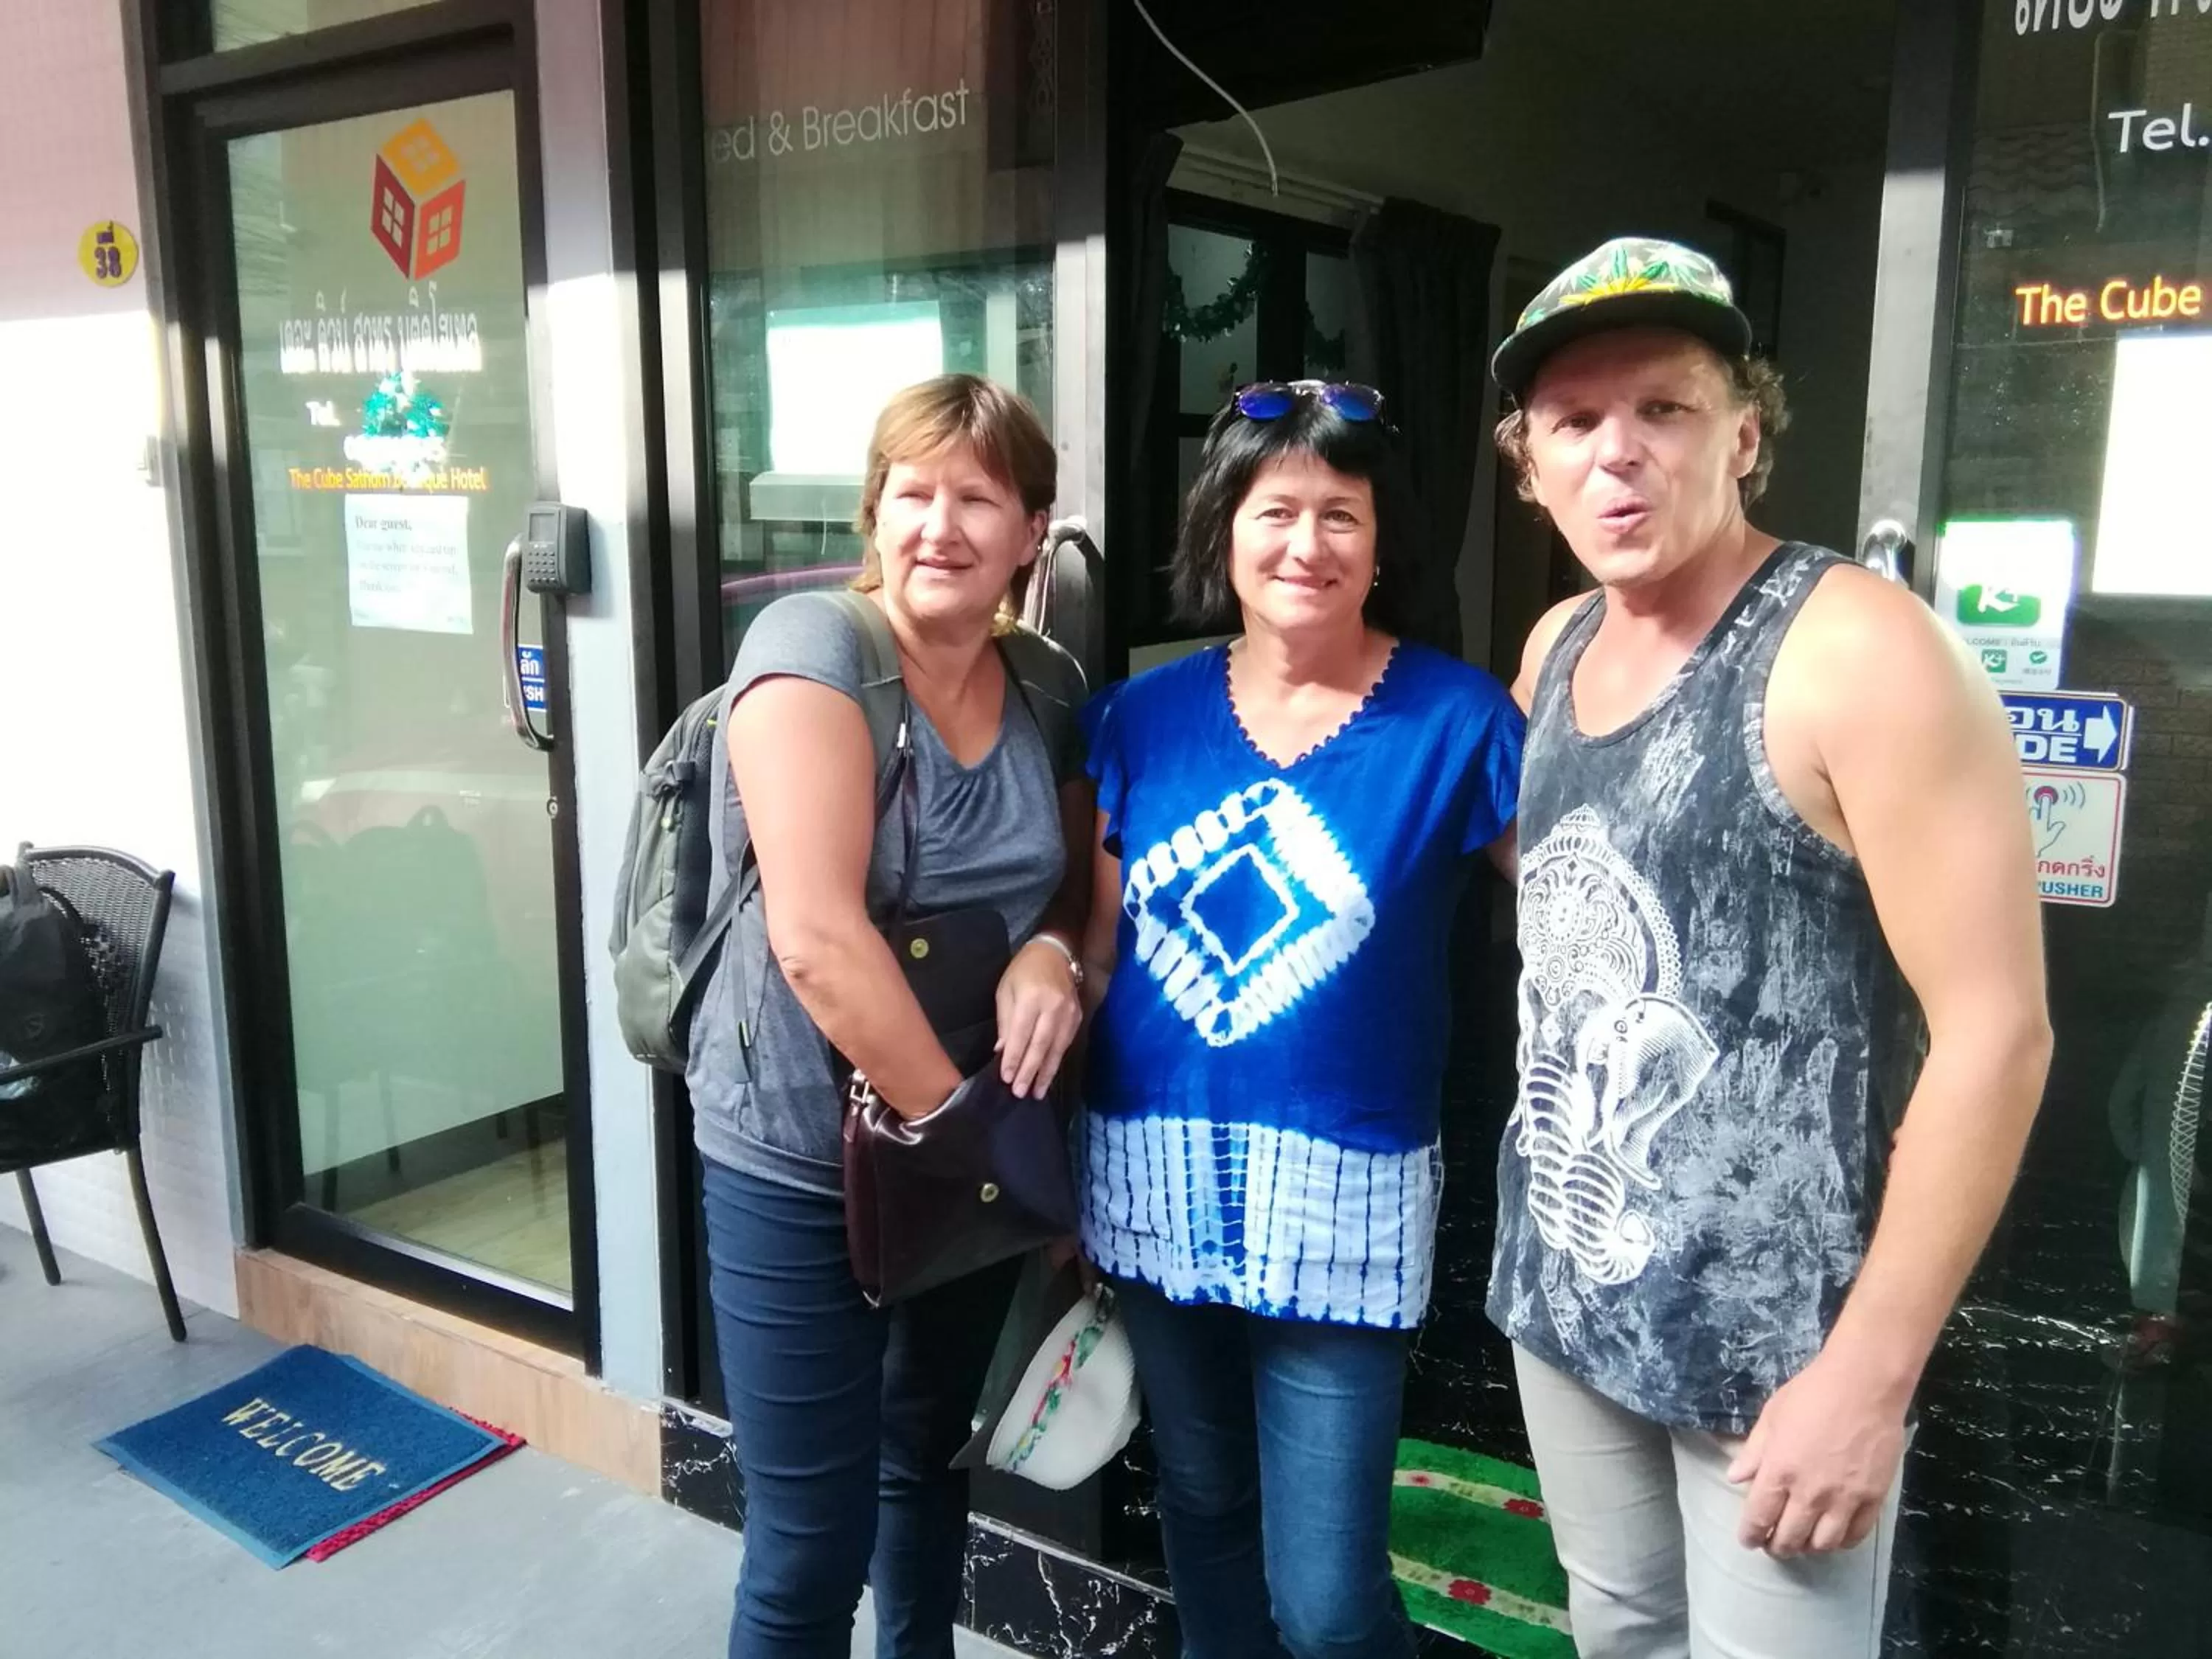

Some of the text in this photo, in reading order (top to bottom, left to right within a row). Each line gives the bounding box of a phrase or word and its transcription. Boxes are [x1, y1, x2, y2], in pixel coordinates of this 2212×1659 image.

[710, 77, 970, 164] ed & Breakfast
[2108, 102, 2211, 153] Tel.
[2015, 274, 2202, 325] The Cube
[288, 467, 311, 490] The
[313, 467, 344, 490] Cube
[451, 467, 487, 490] Hotel
[524, 684, 544, 702] SH
[2004, 706, 2081, 732] อน
[2014, 734, 2079, 763] DE
[2038, 880, 2104, 898] USHER
[222, 1397, 386, 1491] WELCOME
